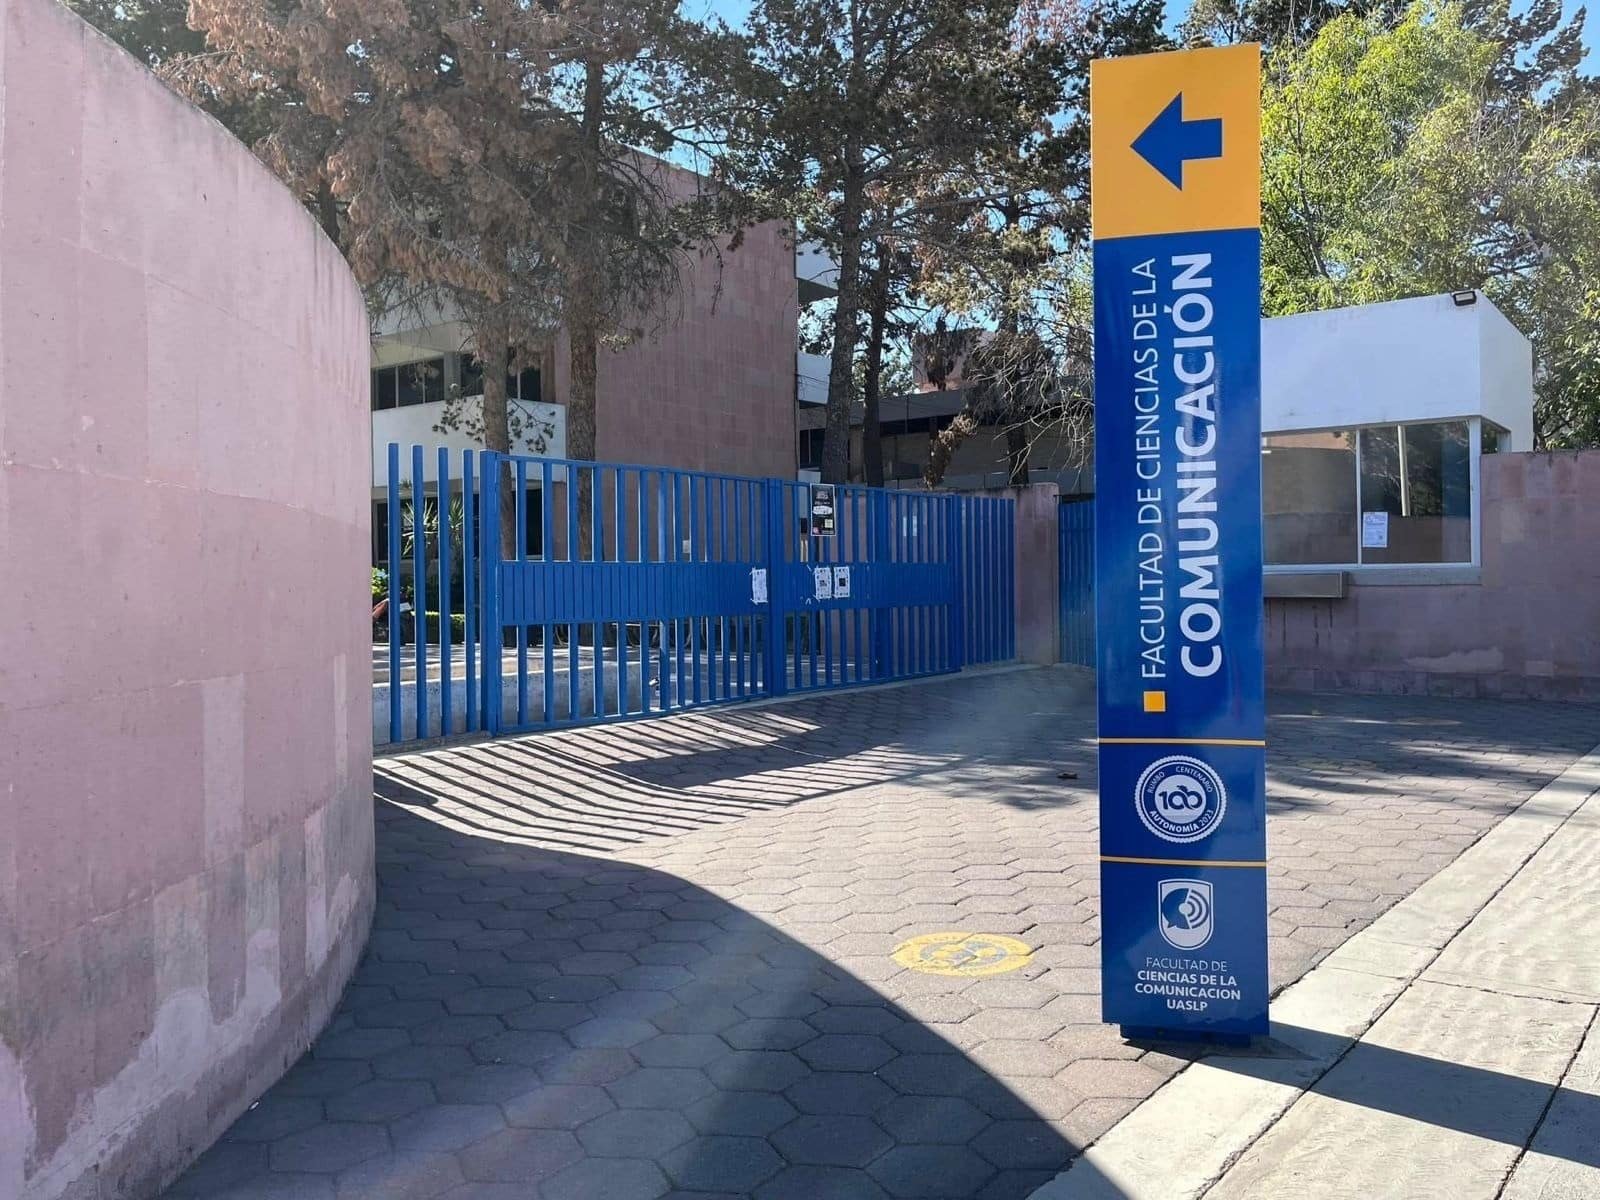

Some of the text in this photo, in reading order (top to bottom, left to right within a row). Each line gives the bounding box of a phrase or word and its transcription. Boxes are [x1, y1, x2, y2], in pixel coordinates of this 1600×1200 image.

[1131, 257, 1166, 678] FACULTAD DE CIENCIAS DE LA
[1164, 252, 1222, 677] COMUNICACIÓN
[1147, 766, 1213, 794] RUMBO CENTENARIO
[1149, 810, 1200, 833] AUTONOMÍA
[1146, 957, 1227, 972] FACULTAD DE
[1137, 970, 1238, 987] CIENCIAS DE LA
[1135, 983, 1241, 1000] COMUNICACION
[1166, 999, 1208, 1012] UASLP
